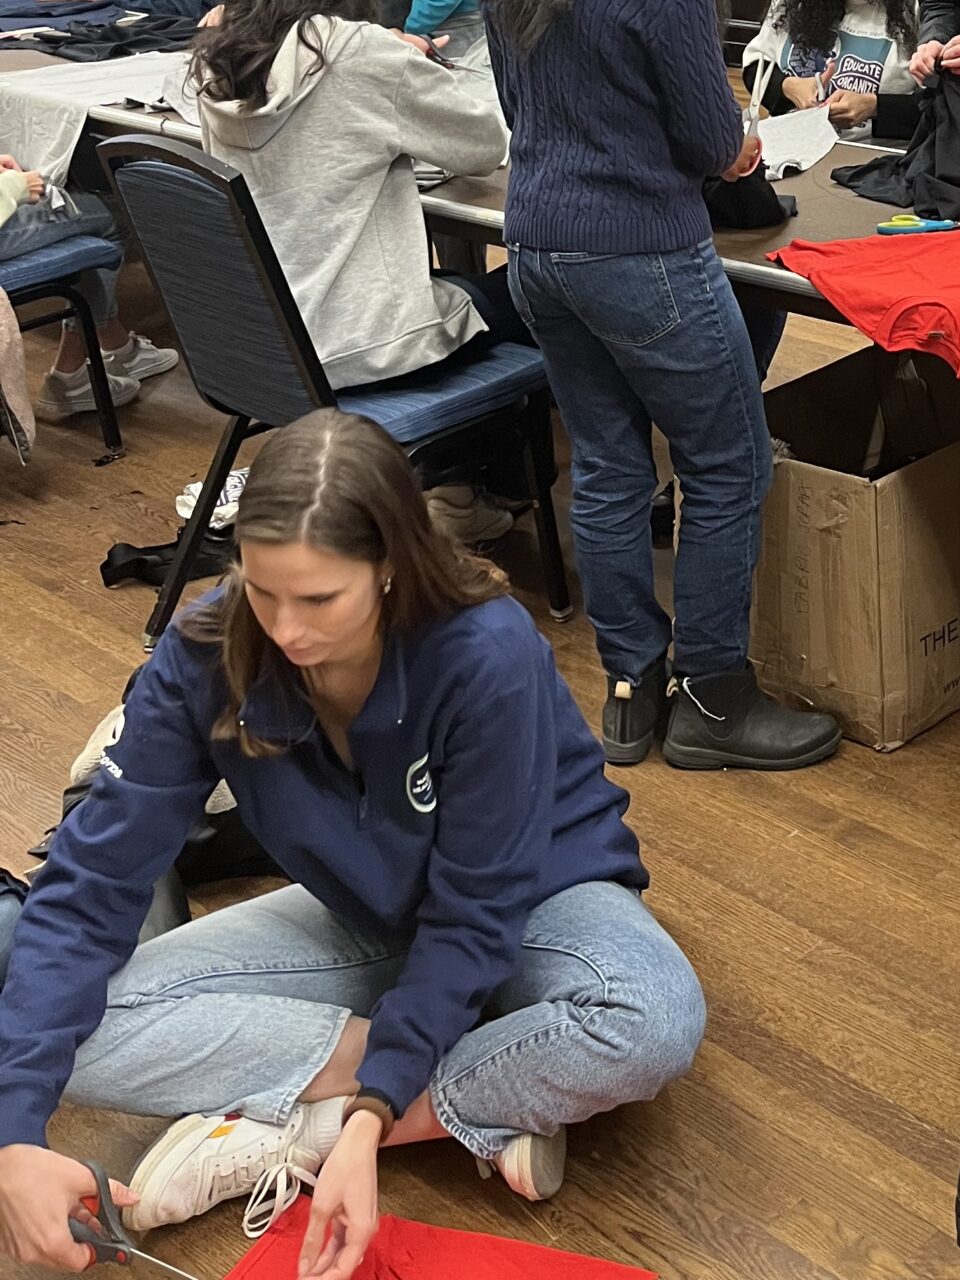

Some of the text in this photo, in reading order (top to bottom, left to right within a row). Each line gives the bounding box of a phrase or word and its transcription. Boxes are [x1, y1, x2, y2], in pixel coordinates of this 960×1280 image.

[842, 57, 882, 78] EDUCATE
[836, 76, 878, 94] ORGANIZE
[919, 618, 959, 657] THE
